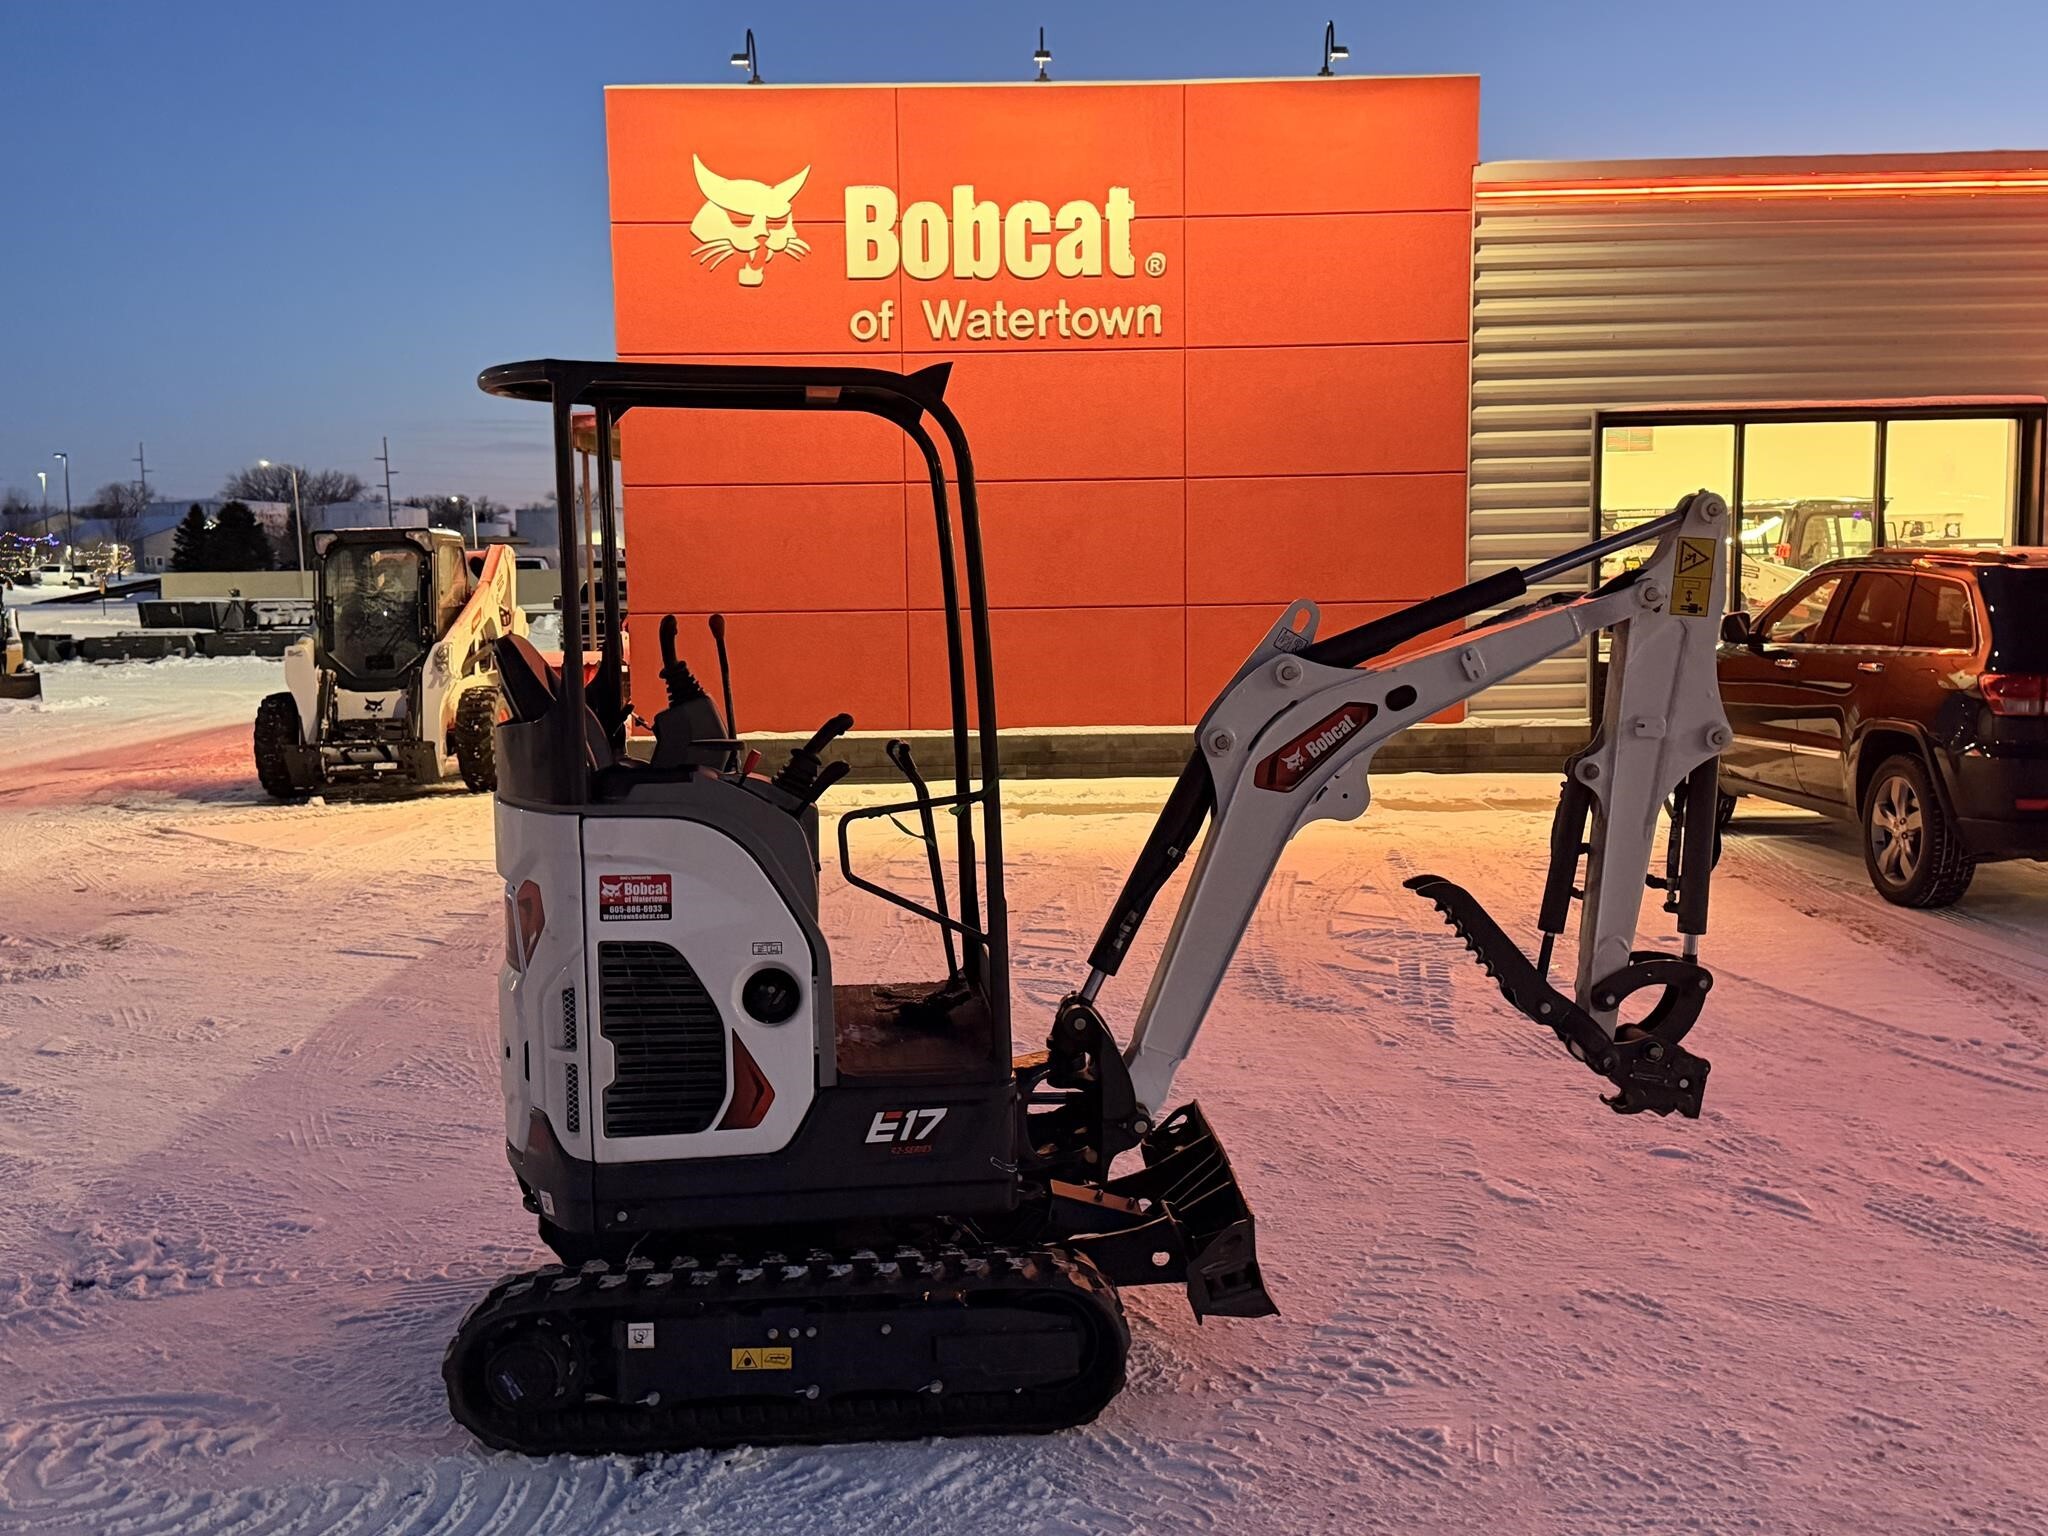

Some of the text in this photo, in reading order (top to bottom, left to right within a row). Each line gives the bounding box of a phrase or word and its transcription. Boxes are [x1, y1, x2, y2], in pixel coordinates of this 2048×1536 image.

[844, 184, 1135, 279] Bobcat
[849, 299, 1163, 341] of Watertown
[1305, 714, 1357, 758] Bobcat
[624, 882, 668, 895] Bobcat
[632, 895, 668, 903] Watertown
[865, 1108, 948, 1143] E17
